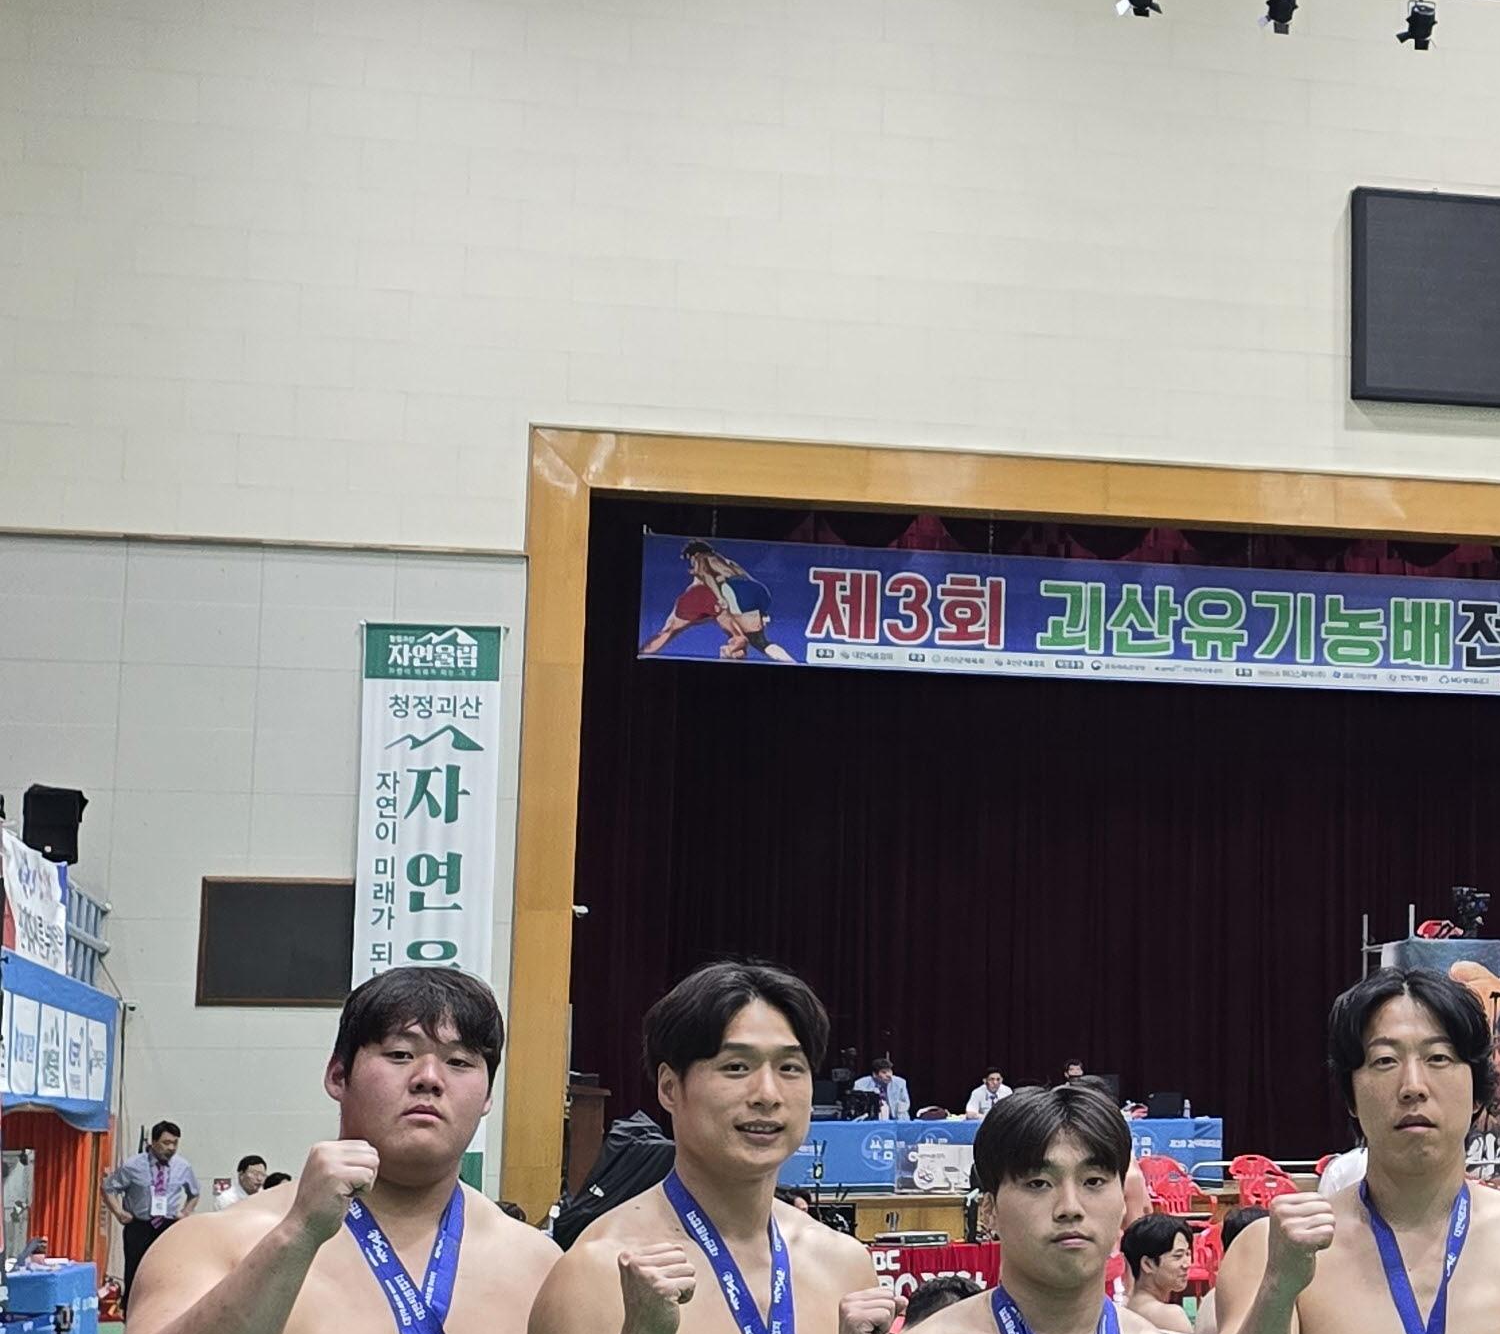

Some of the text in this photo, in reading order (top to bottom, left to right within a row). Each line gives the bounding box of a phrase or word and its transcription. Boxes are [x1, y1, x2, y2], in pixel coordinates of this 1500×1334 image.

[809, 567, 1006, 650] 제3회
[388, 644, 479, 668] 자연울림
[388, 693, 483, 720] 청정괴산
[370, 771, 400, 976] 자연이 미래가 되
[871, 1249, 900, 1271] BC
